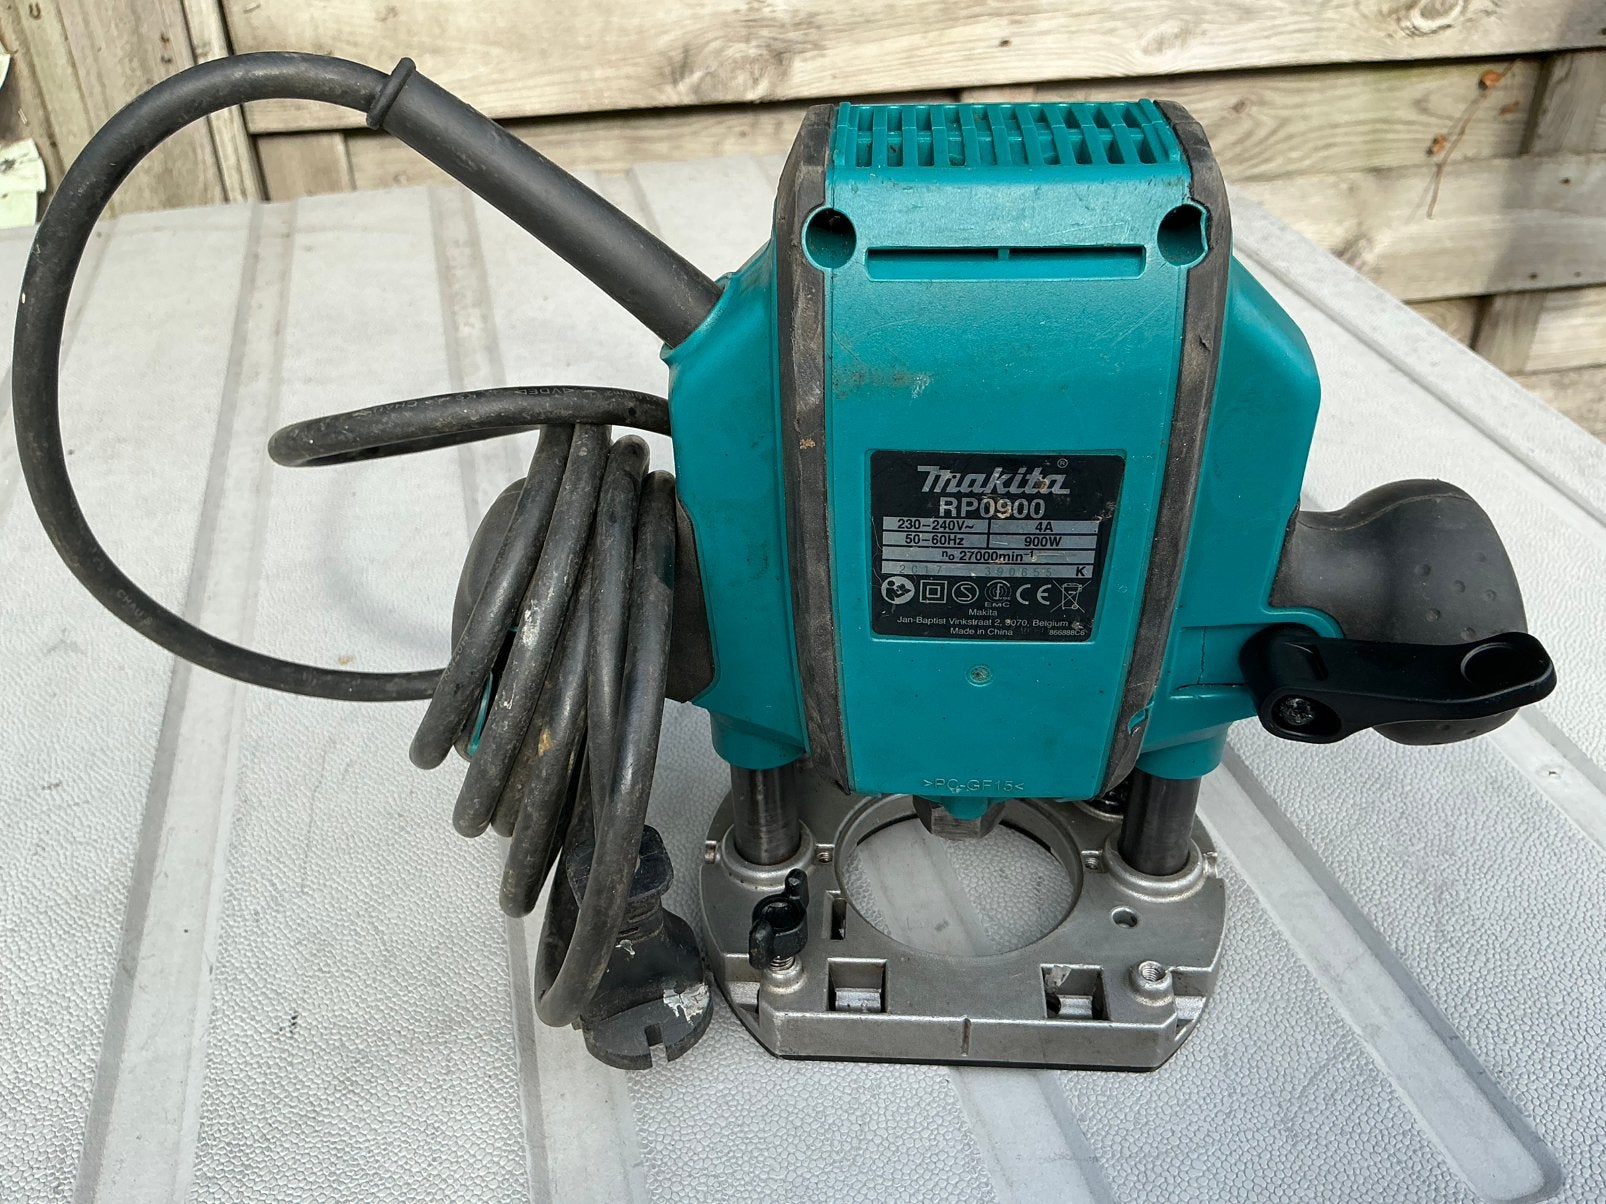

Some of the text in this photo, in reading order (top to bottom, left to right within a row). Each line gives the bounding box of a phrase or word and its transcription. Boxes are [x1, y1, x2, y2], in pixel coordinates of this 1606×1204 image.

[917, 465, 1071, 495] Makita
[939, 496, 1046, 519] RP0900
[1035, 521, 1054, 533] 4A
[904, 533, 965, 546] 50-60Hz
[1024, 536, 1062, 548] 900W
[1075, 566, 1086, 577] K
[968, 608, 998, 616] Makita
[896, 616, 947, 625] Jan-Baptist
[948, 618, 992, 626] Vinkstraat
[1032, 619, 1069, 629] Belgium
[950, 627, 1013, 636] Made in China
